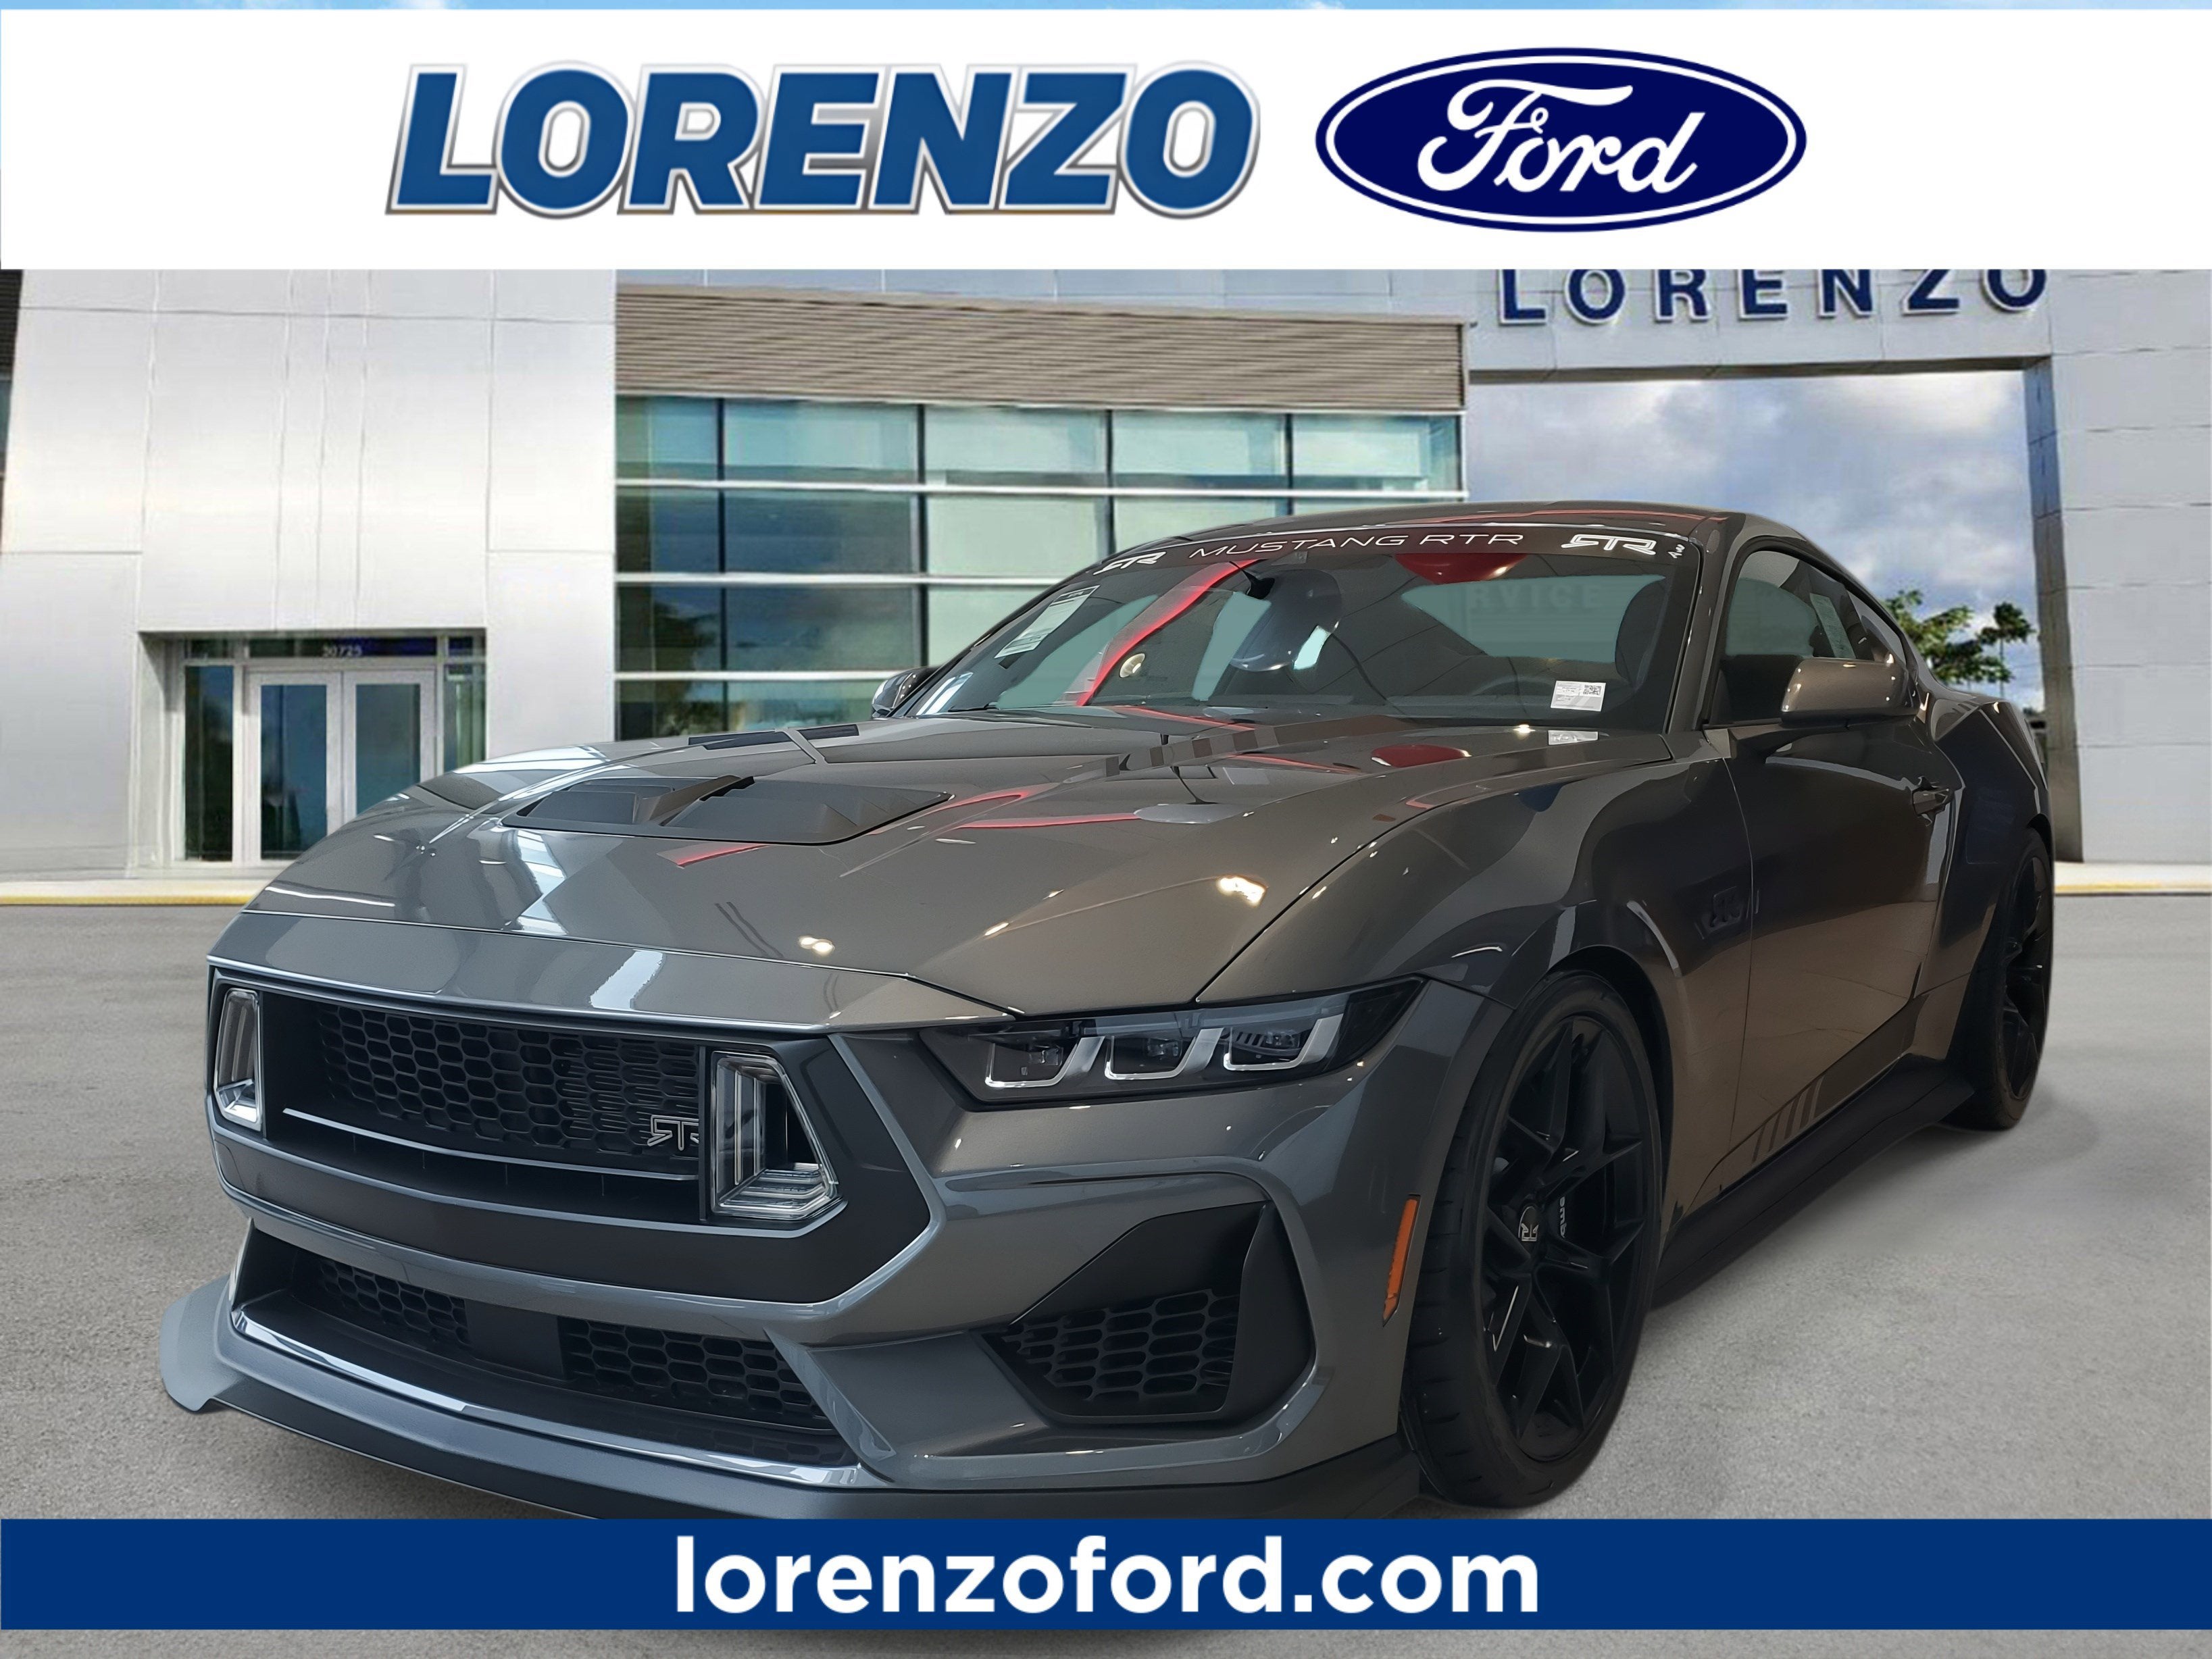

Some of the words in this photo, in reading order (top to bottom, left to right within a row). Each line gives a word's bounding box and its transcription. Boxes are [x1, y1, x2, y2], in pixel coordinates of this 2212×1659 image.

[1499, 270, 2046, 323] LORENZO
[1188, 537, 1409, 559] MUSTANG
[1419, 534, 1524, 545] RTR
